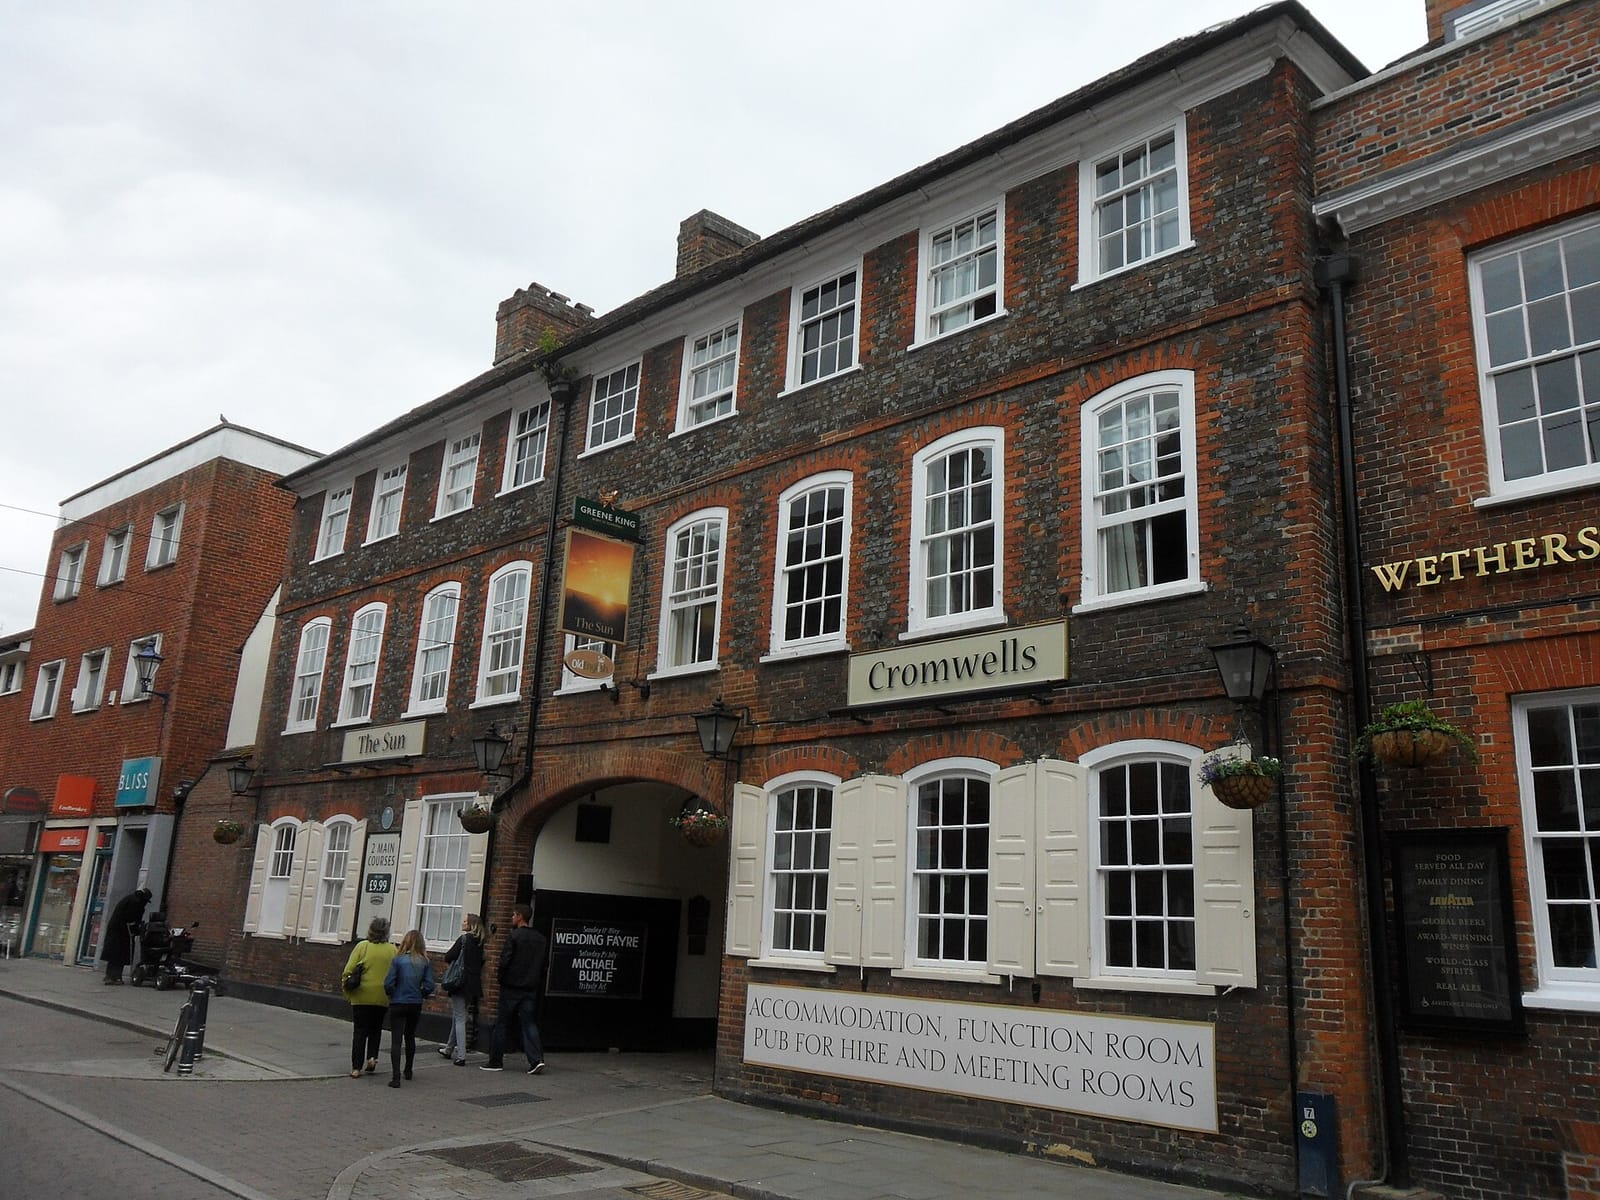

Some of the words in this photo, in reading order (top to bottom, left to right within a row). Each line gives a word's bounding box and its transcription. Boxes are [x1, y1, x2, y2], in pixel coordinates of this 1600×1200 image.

[580, 505, 614, 522] GREENE
[614, 515, 636, 528] KING
[1371, 526, 1600, 592] WETHERS
[575, 616, 594, 631] The
[597, 623, 614, 636] Sun
[571, 658, 585, 670] Old
[868, 638, 1037, 690] Cromwells
[358, 733, 380, 754] The
[382, 731, 406, 752] Sun
[118, 772, 149, 791] BLISS
[371, 843, 376, 854] 2
[377, 842, 395, 854] MAIN
[367, 855, 396, 867] COURSES
[1435, 853, 1462, 862] FOOD
[1449, 862, 1465, 870] ALL
[1467, 862, 1485, 870] DAY
[368, 879, 388, 892] £9.99
[1417, 878, 1448, 886] FAMILY
[1450, 878, 1484, 886] DINING
[1422, 917, 1456, 926] GLOBAL
[1458, 918, 1486, 926] BEERS
[555, 932, 604, 946] WEDDING
[606, 935, 640, 948] FAYRE
[1417, 933, 1494, 942] AWARD-WINNING
[571, 958, 617, 971] MICHAEL
[1425, 956, 1489, 967] WORLD-CLASS
[578, 970, 614, 982] BUBLE
[1440, 967, 1474, 975] SPIRITS
[1436, 982, 1457, 990] REAL
[1461, 983, 1482, 991] ALES
[748, 997, 948, 1042] ACCOMMODATION,
[957, 1017, 1094, 1056] FUNCTION
[1104, 1033, 1205, 1068] ROOM
[753, 1026, 789, 1050] PUB
[795, 1032, 834, 1058] FOR
[840, 1038, 889, 1065] HIRE
[895, 1045, 946, 1073] AND
[953, 1054, 1070, 1091] MEETING
[1081, 1068, 1195, 1108] ROOMS
